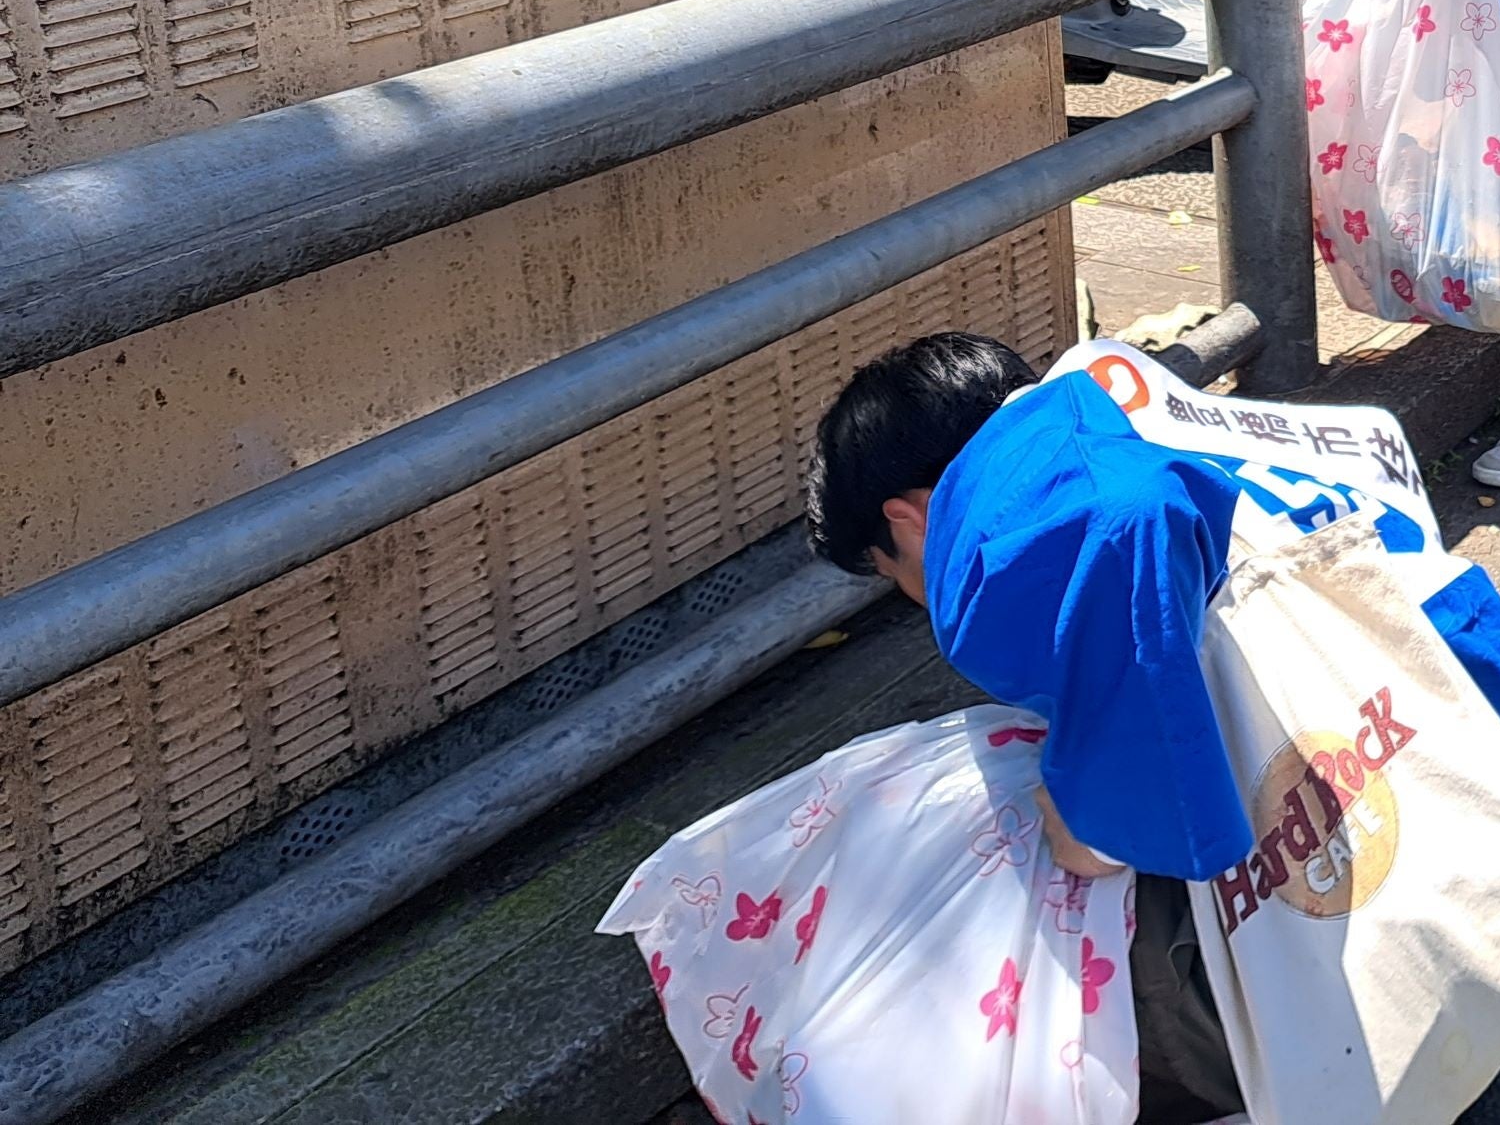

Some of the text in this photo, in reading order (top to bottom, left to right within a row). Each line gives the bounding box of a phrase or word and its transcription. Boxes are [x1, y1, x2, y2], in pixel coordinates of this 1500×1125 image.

[1211, 685, 1418, 938] Hard Rock
[1303, 798, 1384, 894] CAFE
